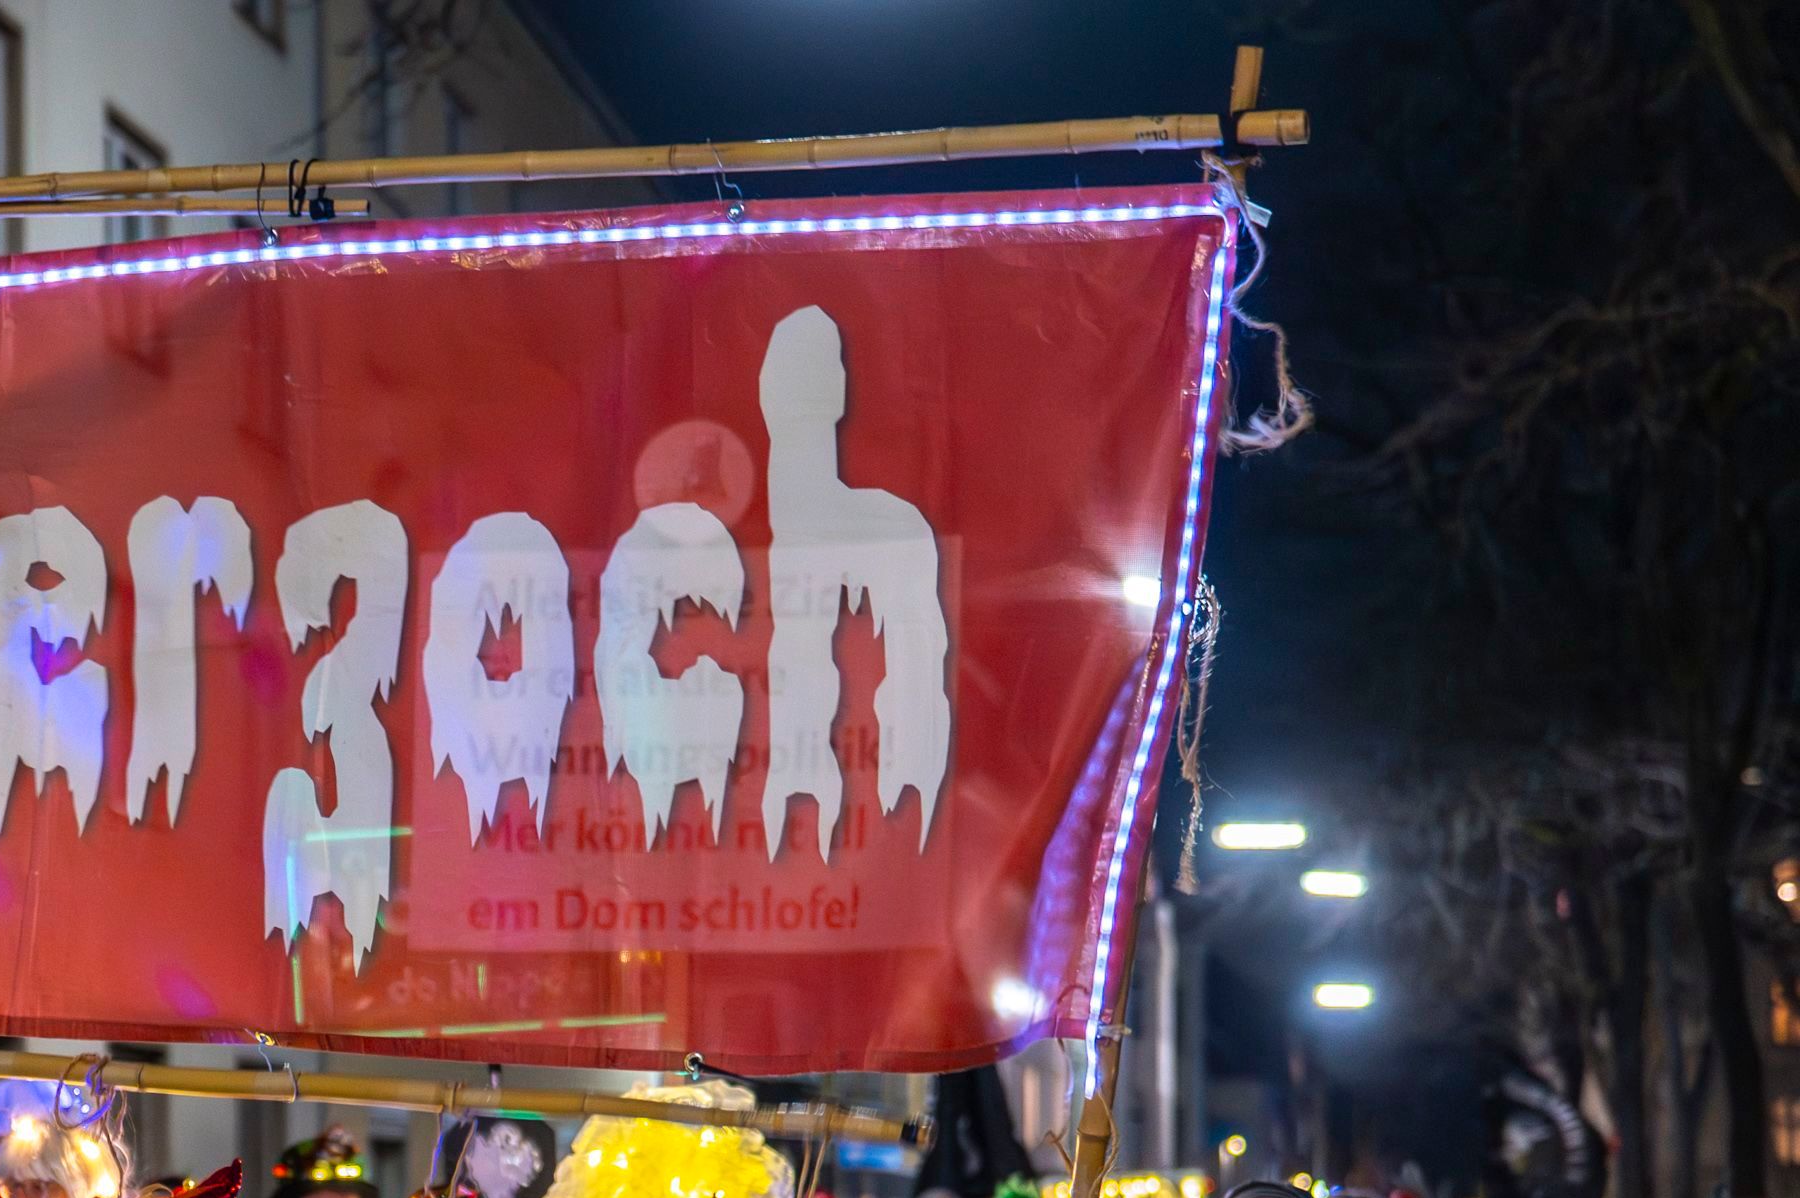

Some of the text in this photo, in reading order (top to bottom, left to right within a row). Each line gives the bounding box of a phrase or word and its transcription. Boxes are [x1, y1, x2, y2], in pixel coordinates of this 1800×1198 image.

[472, 810, 565, 853] Mer
[736, 808, 804, 853] nt
[466, 882, 861, 931] em Dom schlofe!
